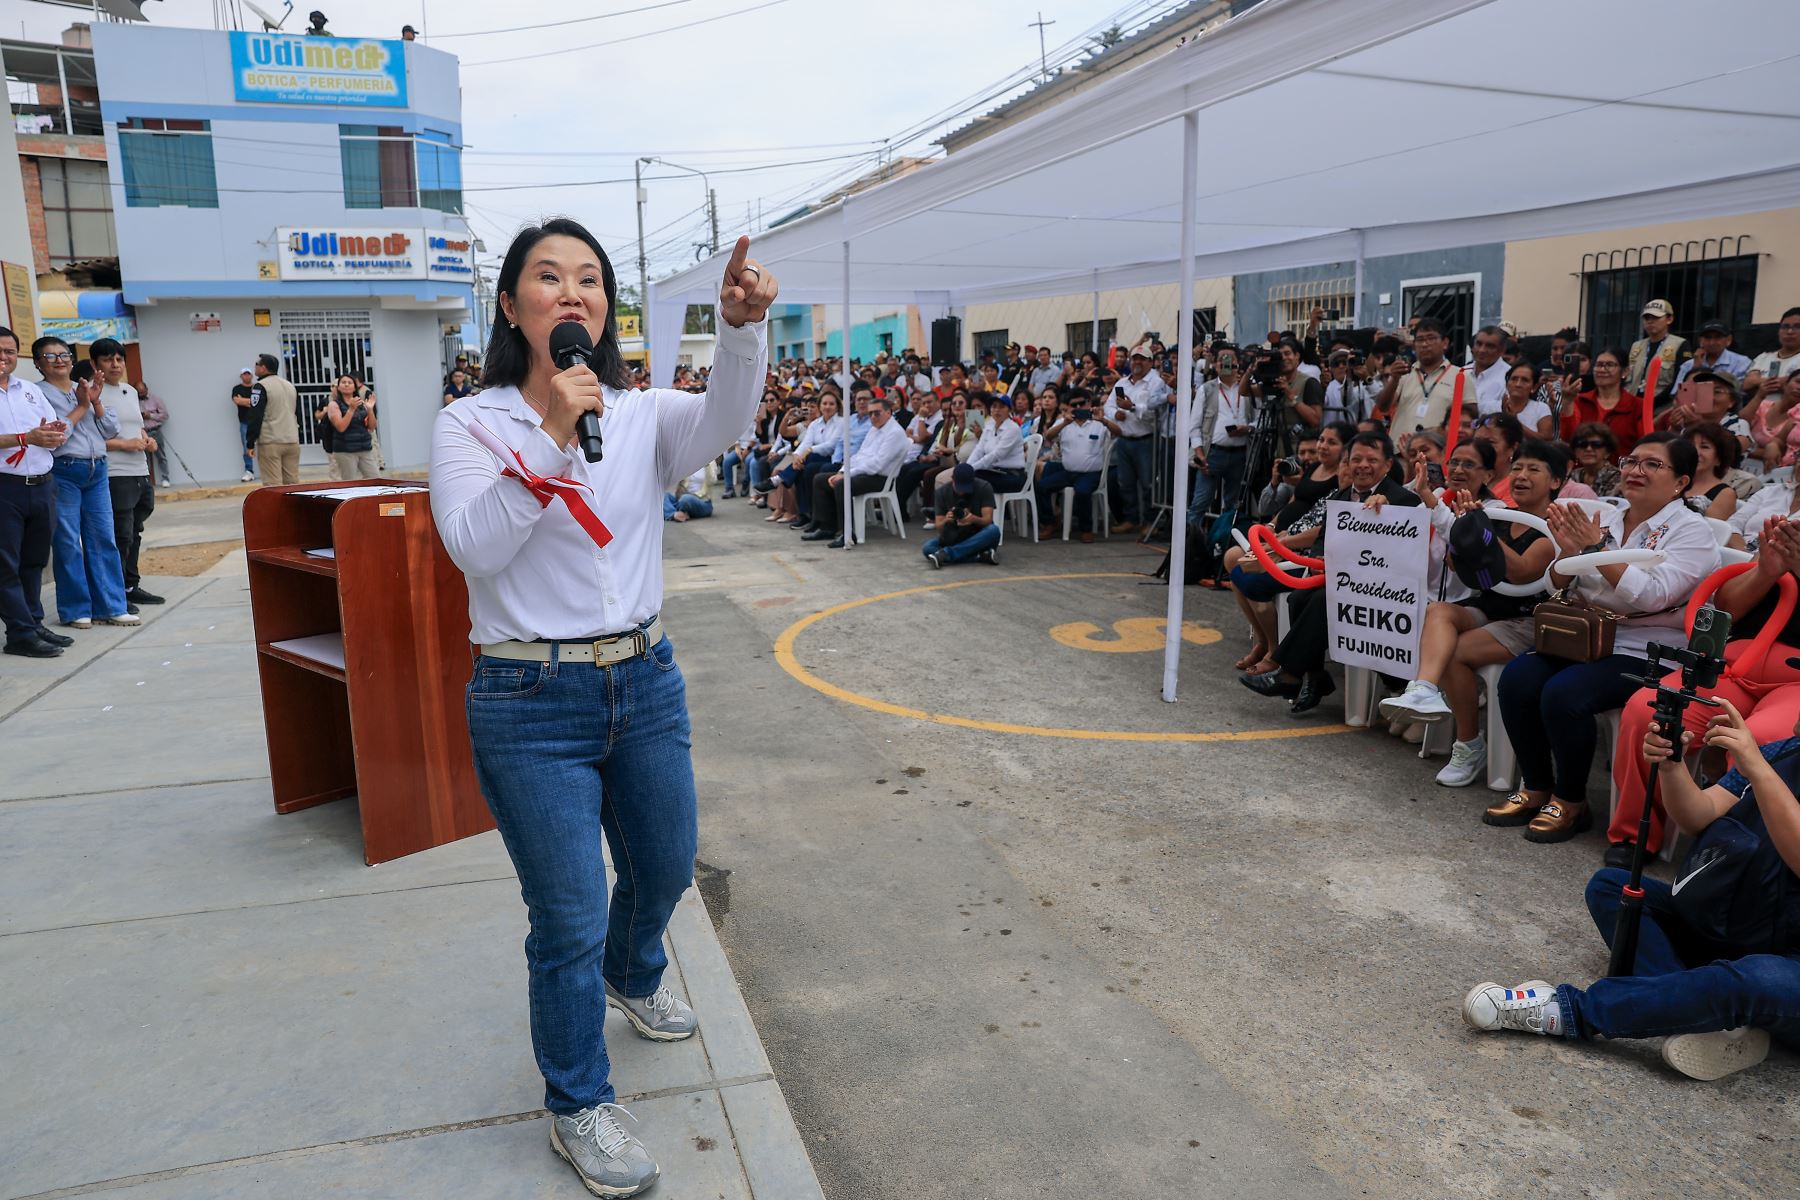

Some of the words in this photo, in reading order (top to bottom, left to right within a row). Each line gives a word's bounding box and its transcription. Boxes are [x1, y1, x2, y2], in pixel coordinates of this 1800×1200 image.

[247, 73, 298, 88] BOTICA
[309, 76, 394, 91] PERFUMERÍA
[294, 260, 335, 269] BOTICA
[1337, 511, 1419, 538] Bienvenida
[1358, 550, 1389, 568] Sra.
[1336, 572, 1416, 605] Presidenta
[1337, 602, 1412, 634] KEIKO
[1337, 635, 1412, 664] FUJIMORI
